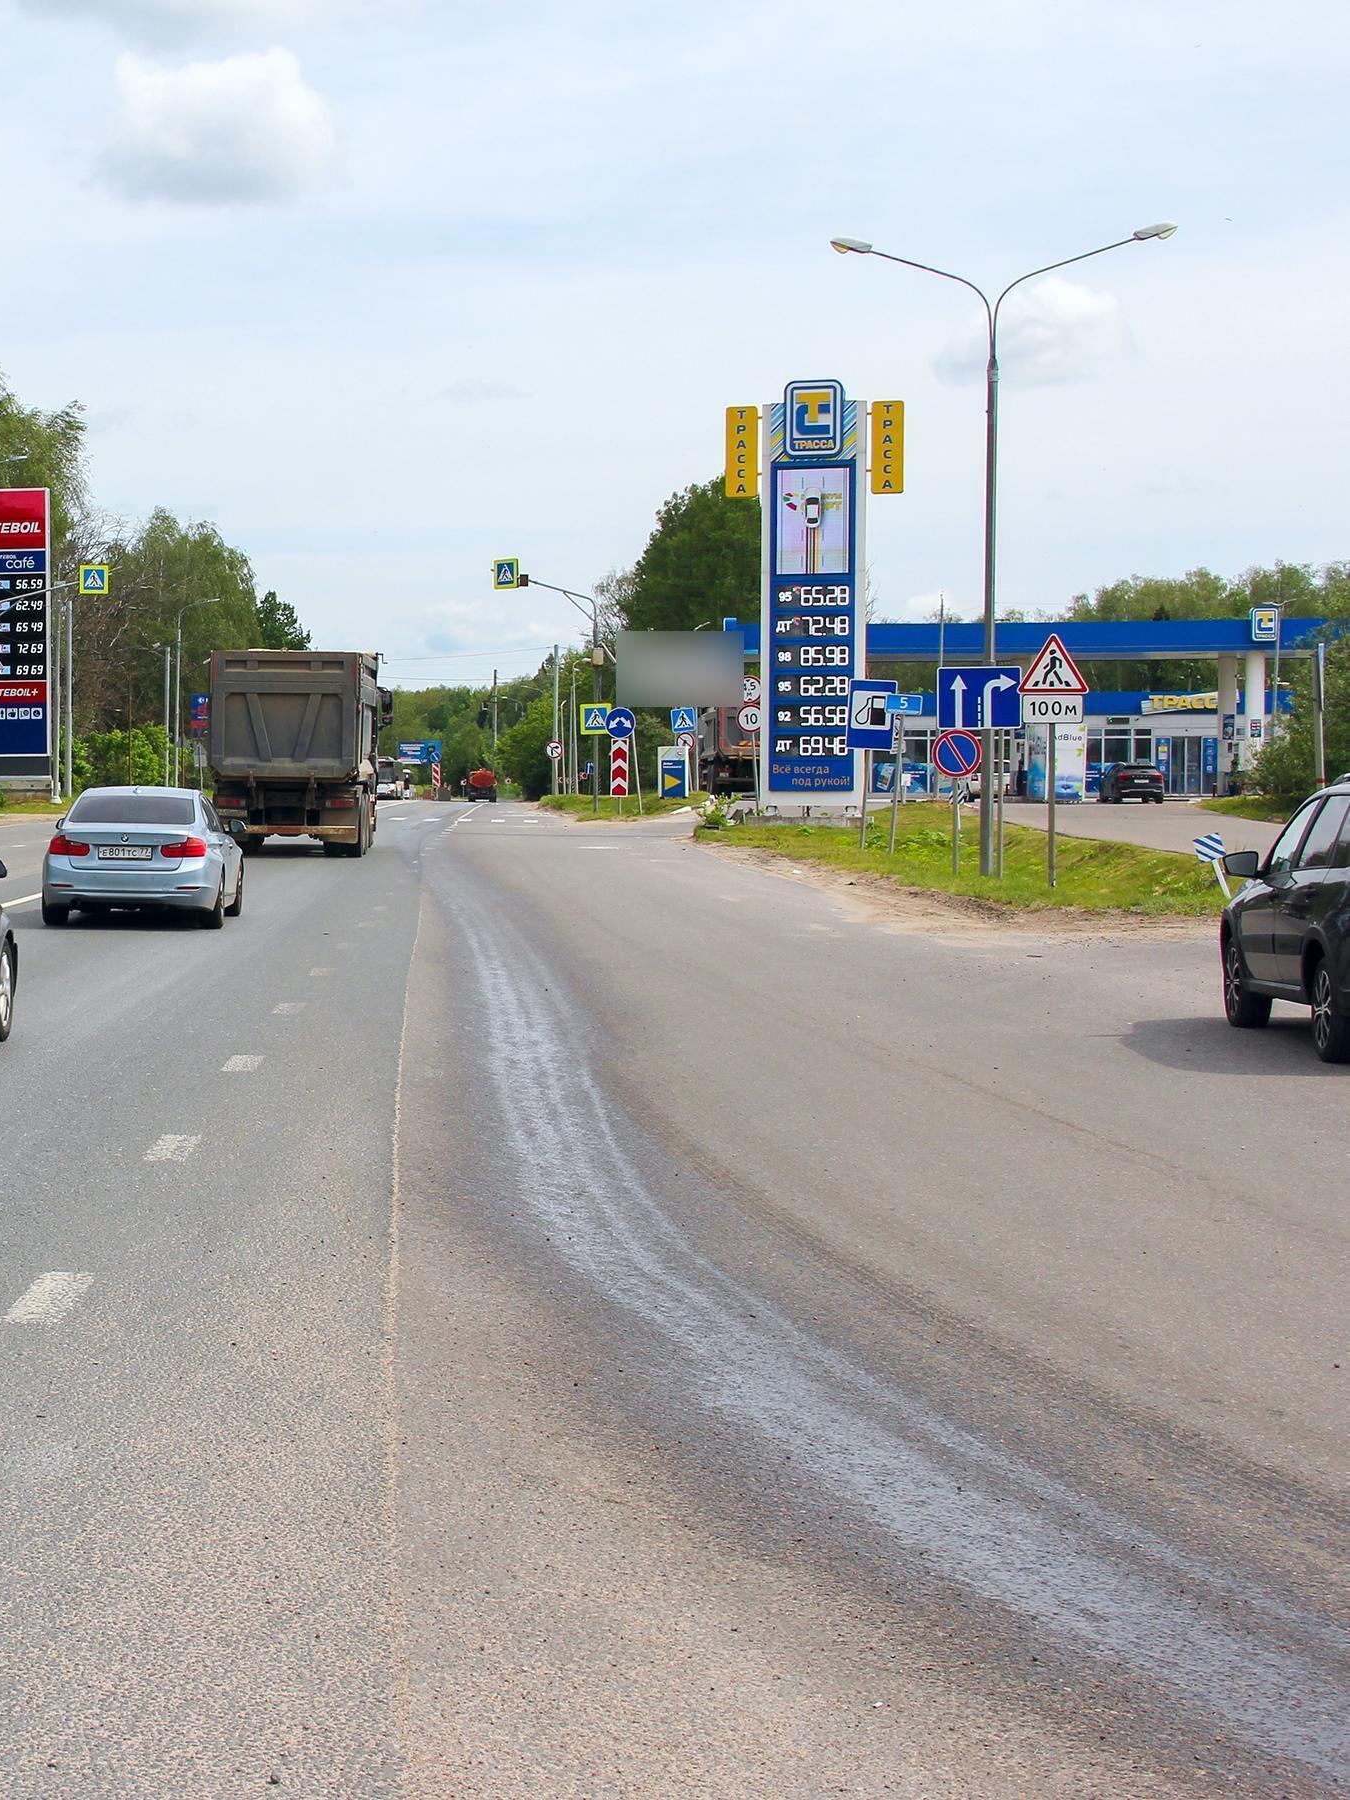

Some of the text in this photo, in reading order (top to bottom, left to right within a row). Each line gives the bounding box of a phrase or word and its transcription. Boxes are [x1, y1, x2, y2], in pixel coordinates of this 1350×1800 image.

[793, 439, 835, 450] ТРАССА
[882, 404, 893, 490] ТРАССА
[736, 410, 746, 493] ТРАССА
[5, 556, 35, 569] café
[15, 579, 43, 590] 56.59
[778, 585, 849, 606] 95 65.28
[15, 600, 44, 611] 62.49
[776, 616, 849, 636] ДТ 72.48
[778, 646, 849, 666] 98 85.98
[777, 676, 849, 696] 95 62.28
[900, 697, 908, 709] 5
[1149, 694, 1218, 710] ТРАСС
[744, 713, 758, 725] 10
[777, 706, 848, 726] 92 56.58
[776, 740, 793, 752] ДТ
[772, 764, 830, 775] Всё всегда
[791, 776, 850, 787] под рукой!
